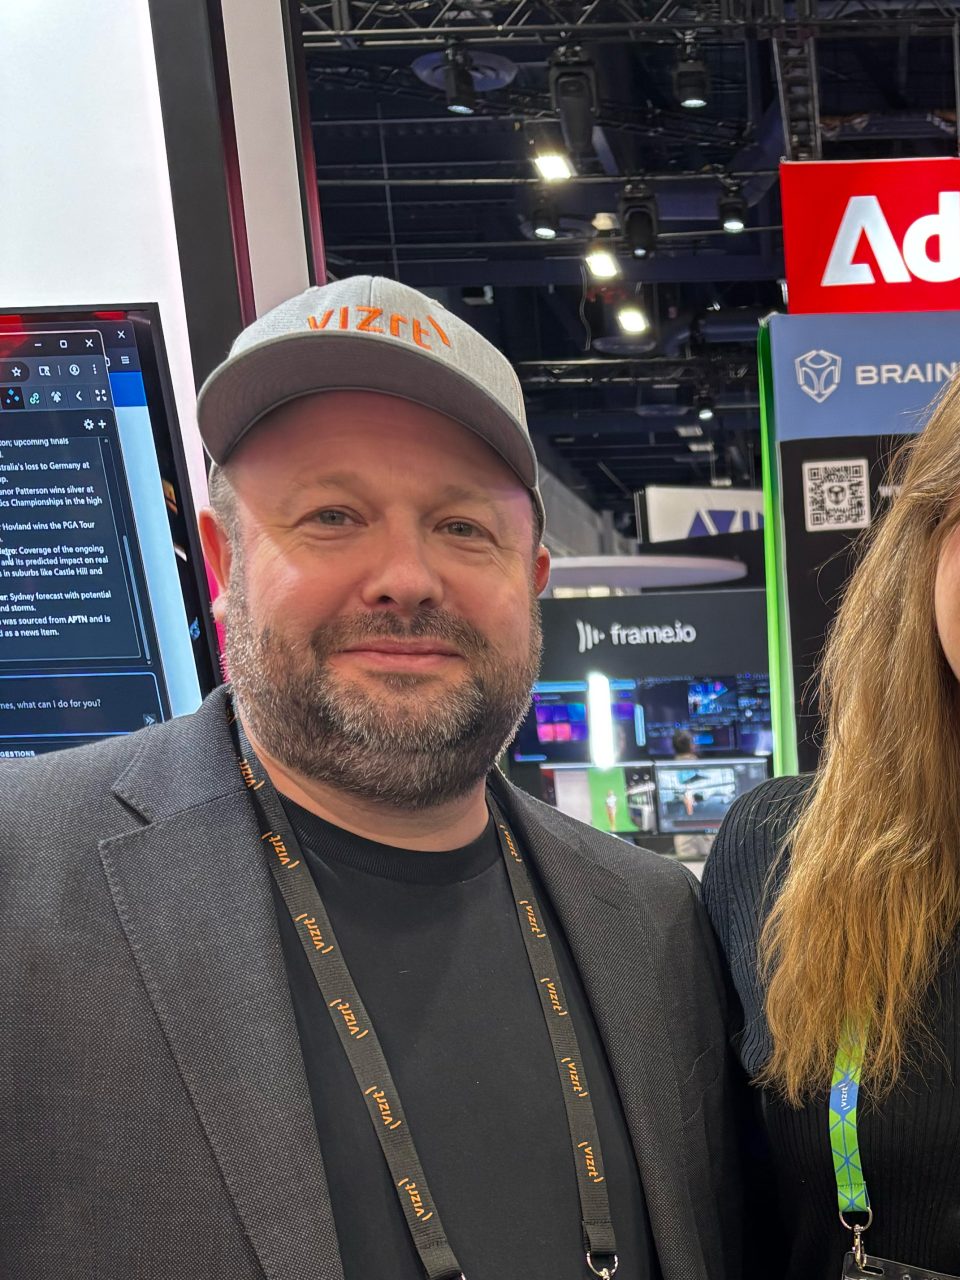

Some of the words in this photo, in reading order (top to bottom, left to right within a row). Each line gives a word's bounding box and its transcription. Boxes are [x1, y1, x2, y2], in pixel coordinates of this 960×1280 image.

[25, 462, 39, 470] loss
[49, 461, 81, 471] Germany
[82, 461, 90, 469] at
[15, 487, 48, 496] Patterson
[49, 486, 66, 494] wins
[67, 485, 84, 493] silver
[86, 485, 94, 493] at
[11, 498, 63, 508] Championships
[65, 497, 72, 505] in
[73, 496, 85, 505] the
[86, 496, 103, 506] high
[2, 522, 31, 531] Hovland
[33, 522, 48, 530] wins
[50, 521, 61, 530] the
[63, 521, 78, 529] PGA
[79, 520, 95, 529] Tour
[19, 546, 51, 556] Coverage
[62, 545, 73, 553] the
[75, 544, 104, 554] ongoing
[25, 557, 58, 567] predicted
[60, 557, 83, 566] impact
[95, 556, 109, 564] real
[12, 568, 39, 577] suburbs
[40, 568, 52, 576] like
[54, 567, 75, 576] Castle
[76, 567, 88, 575] Hill
[89, 566, 103, 575] and
[10, 593, 34, 602] Sydney
[36, 591, 63, 600] forecast
[65, 591, 80, 600] with
[81, 590, 111, 600] potential
[19, 616, 47, 625] sourced
[49, 615, 67, 624] from
[68, 615, 88, 624] APTN
[89, 615, 103, 623] and
[20, 629, 39, 637] news
[17, 700, 36, 709] what
[58, 700, 68, 708] do
[70, 699, 81, 707] for
[82, 699, 101, 709] you?
